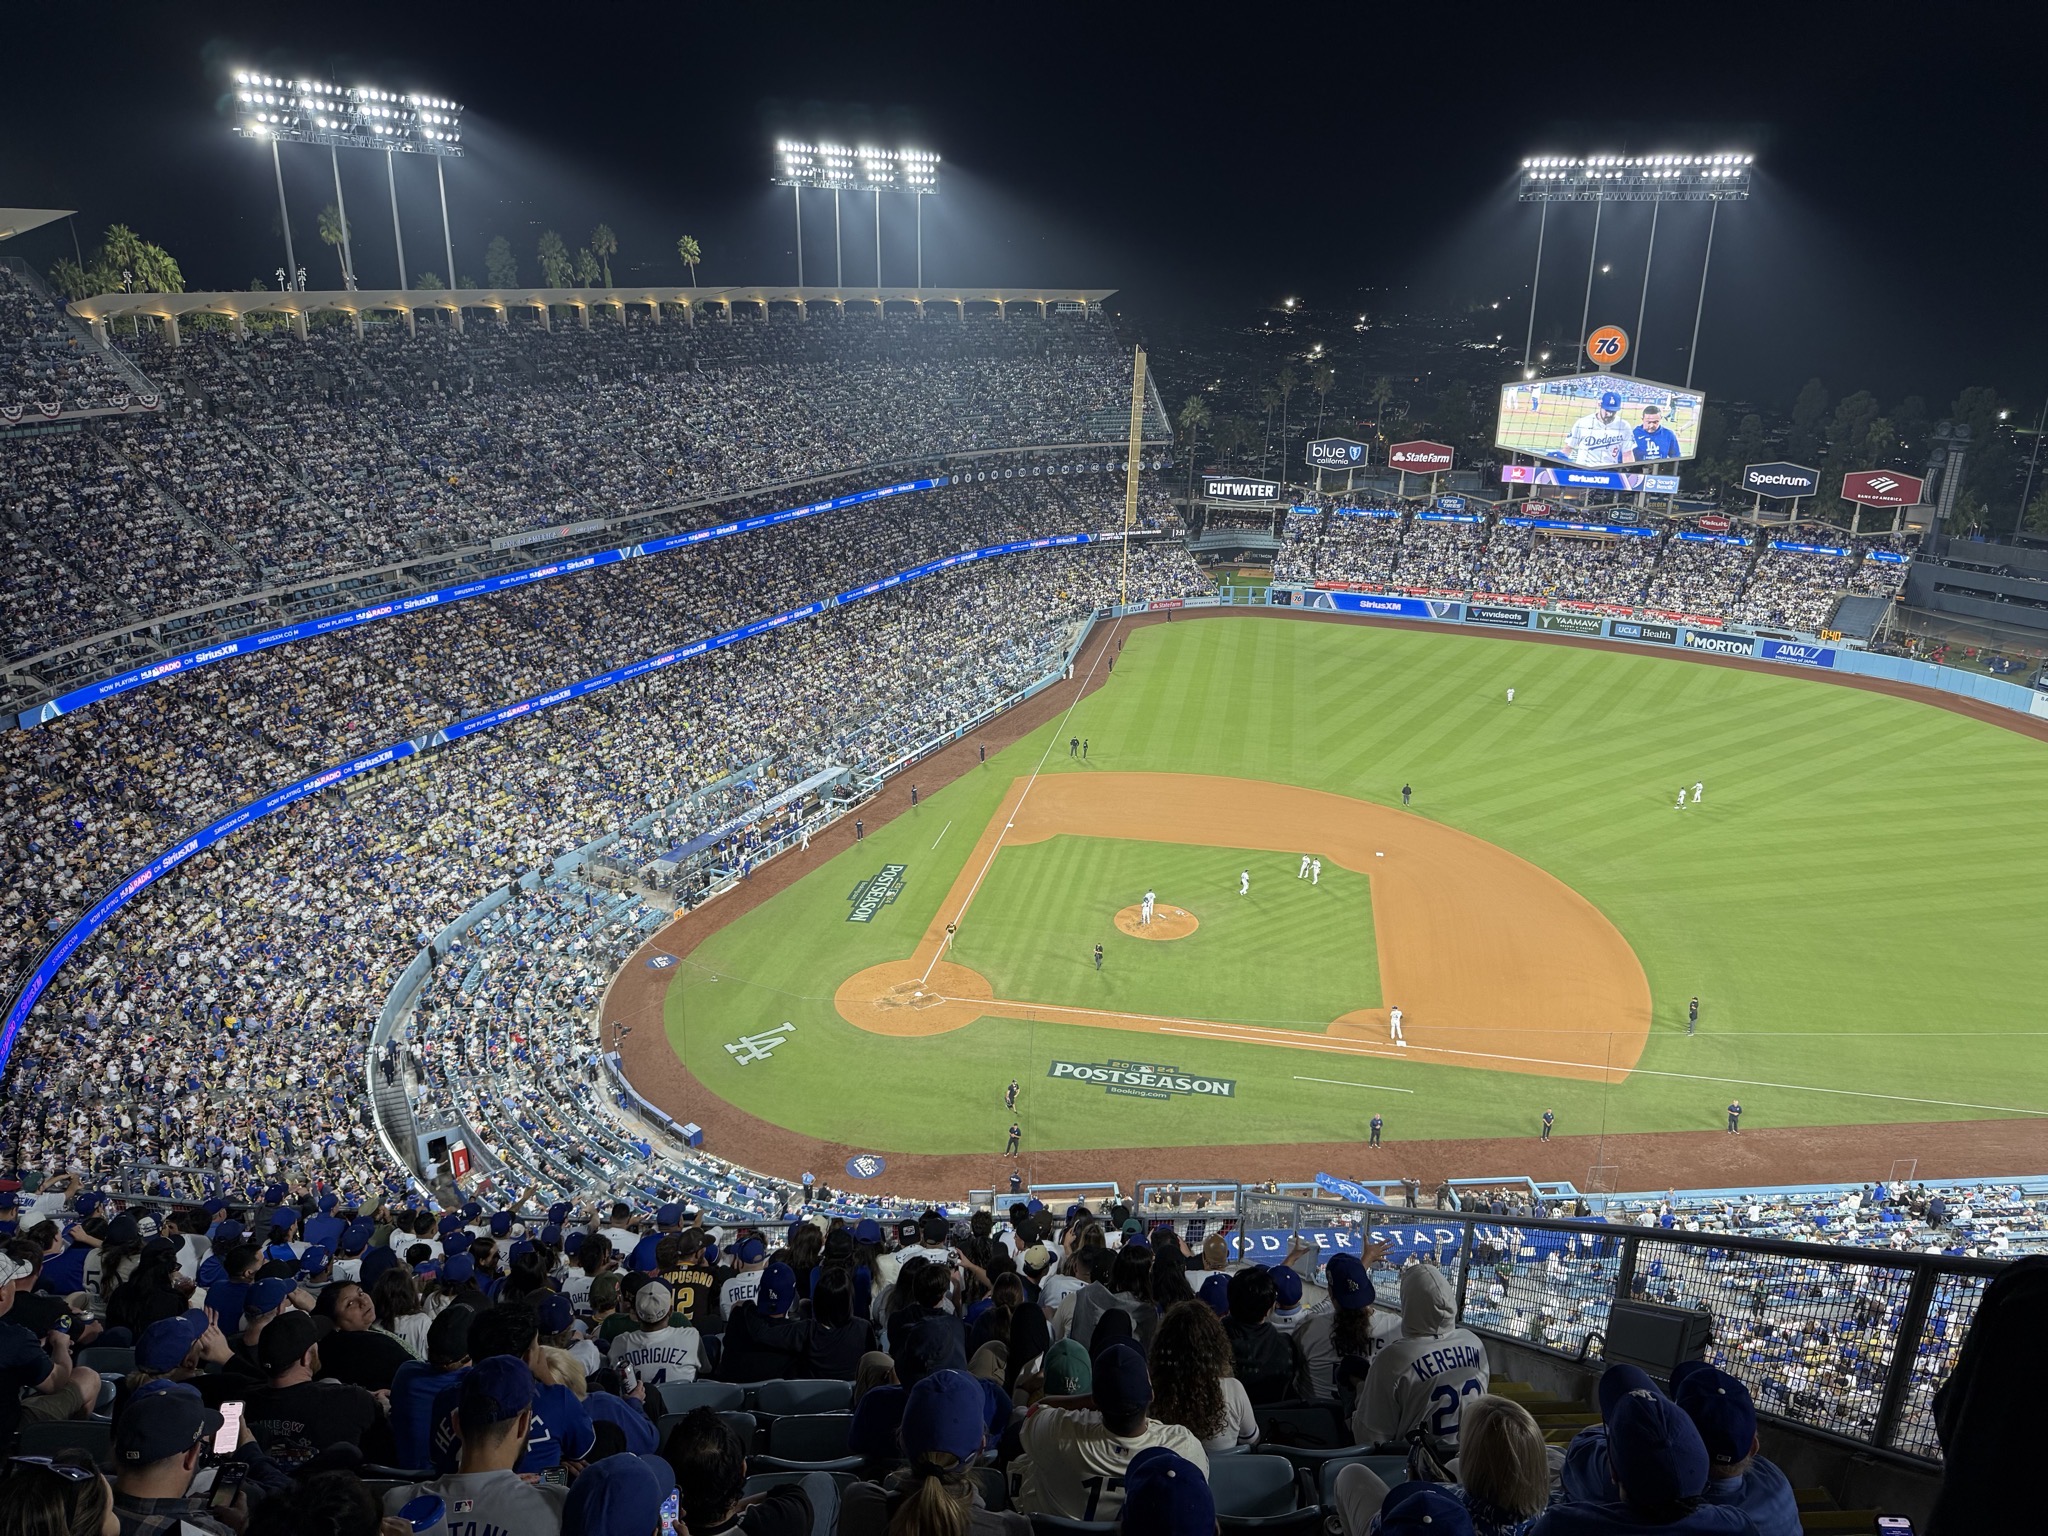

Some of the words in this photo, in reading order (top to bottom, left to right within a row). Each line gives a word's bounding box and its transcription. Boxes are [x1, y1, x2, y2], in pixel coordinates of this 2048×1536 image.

[1594, 337, 1620, 355] 76
[1585, 434, 1624, 449] Dodgers
[1312, 444, 1346, 458] blue
[1316, 457, 1349, 465] california
[1568, 474, 1610, 484] SiriusXM
[1749, 471, 1807, 487] Spectrum
[1208, 482, 1274, 497] CUTWATER
[1525, 503, 1546, 511] JINRO
[317, 621, 330, 630] NOW
[331, 615, 354, 626] PLAYING
[371, 606, 392, 617] RADIO
[403, 594, 439, 610] SiriusXM
[1359, 600, 1402, 611] SiriusXM
[257, 629, 299, 645] SIRIUSXM.COM
[1618, 626, 1638, 635] UCLA
[1642, 628, 1671, 640] Health
[1820, 629, 1842, 642] 0:40
[1693, 636, 1754, 655] MORTON
[1776, 644, 1805, 657] ANA
[99, 684, 113, 694] NOW
[114, 675, 138, 689] PLAYING
[159, 661, 182, 674] RADIO
[184, 657, 194, 665] ON
[195, 643, 239, 663] SiriusXM
[464, 722, 476, 731] NOW
[477, 715, 497, 727] PLAYING
[539, 690, 571, 706] SiriusXM
[266, 796, 279, 808] NOW
[279, 788, 302, 802] PLAYING
[319, 770, 342, 786] RADIO
[343, 766, 352, 774] ON
[353, 750, 393, 772] SiriusXM
[213, 811, 250, 836] SIRIUSXM.COM
[89, 911, 101, 926] NOW
[101, 896, 119, 916] PLAYING
[132, 869, 153, 889] RADIO
[153, 864, 162, 874] ON
[162, 838, 199, 869] SiriusXM
[849, 865, 905, 922] POSTSEASON
[723, 1021, 798, 1066] LA
[1111, 1061, 1129, 1069] 20
[1053, 1062, 1231, 1096] POSTSEASON
[1110, 1087, 1168, 1099] Booking.com
[1371, 1225, 1526, 1249] STADUM
[1411, 1345, 1481, 1382] KERSHAW
